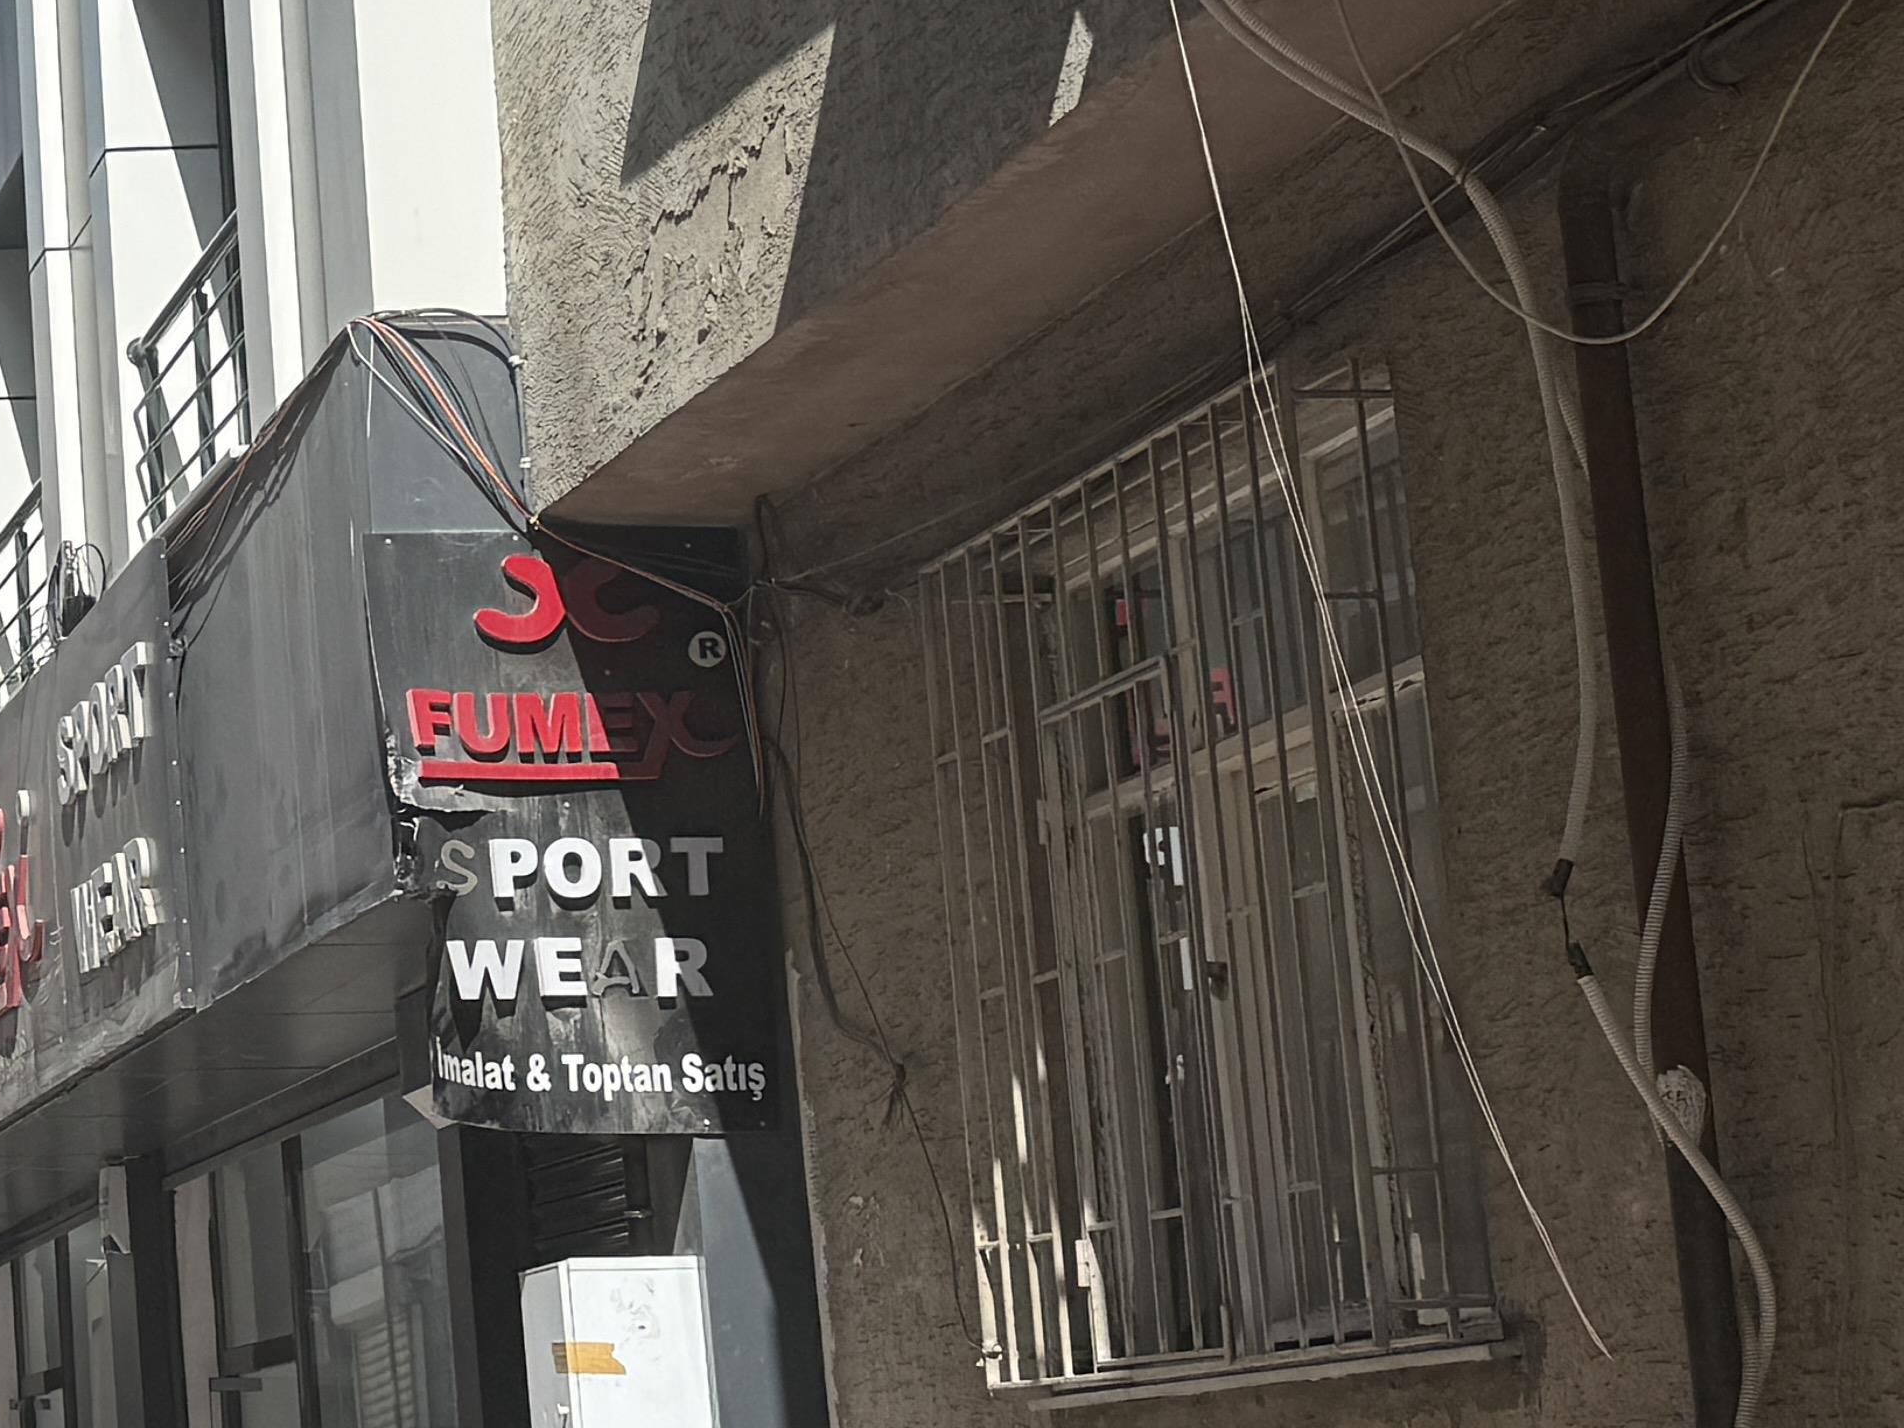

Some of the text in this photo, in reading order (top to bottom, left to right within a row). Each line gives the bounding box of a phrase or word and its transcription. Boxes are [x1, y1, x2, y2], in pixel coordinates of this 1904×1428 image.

[57, 641, 149, 805] SPORT
[406, 687, 742, 778] FUMEX
[70, 837, 160, 973] WEAR
[437, 836, 724, 898] SPORT
[446, 935, 715, 1002] WEAR
[527, 1056, 552, 1092] &
[561, 1053, 672, 1100] Toptan
[682, 1053, 767, 1100] Satış
